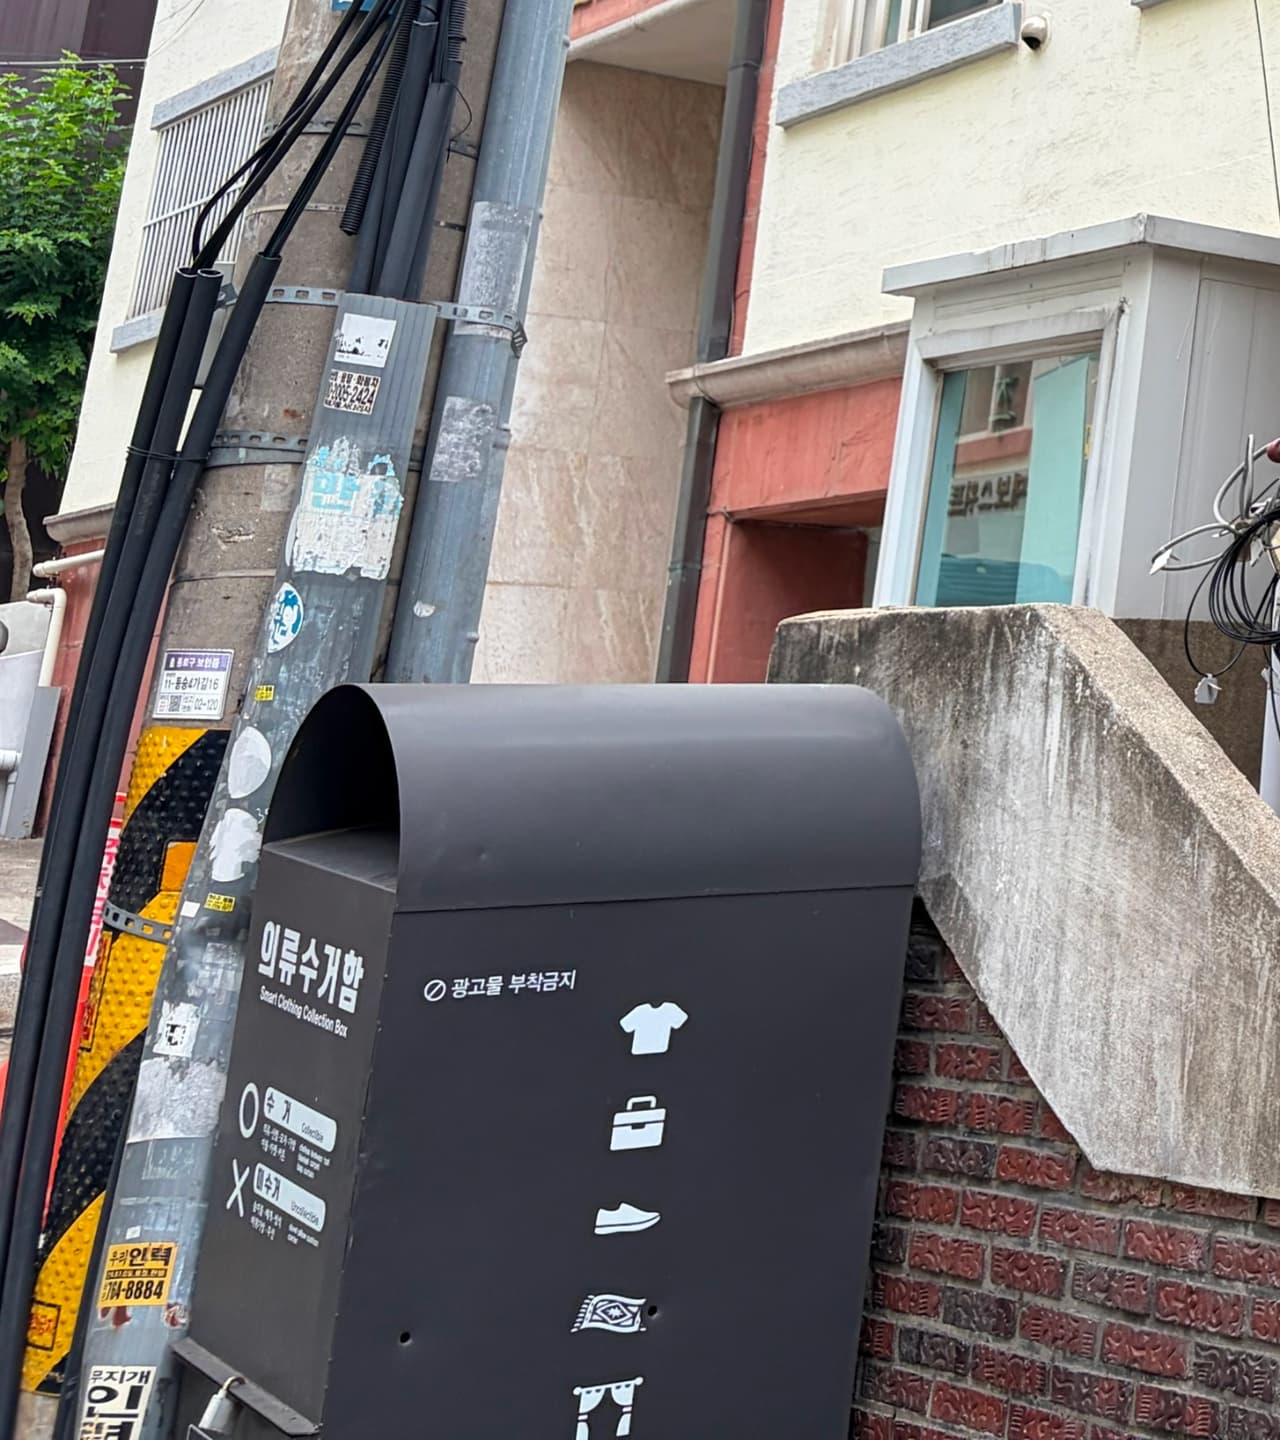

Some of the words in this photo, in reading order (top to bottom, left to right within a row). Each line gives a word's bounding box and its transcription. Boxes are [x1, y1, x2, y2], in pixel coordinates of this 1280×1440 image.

[258, 920, 364, 1014] 의류수거함
[451, 976, 503, 999] 광고물
[508, 969, 577, 994] 부착금지
[260, 985, 278, 1006] Smart
[277, 993, 302, 1020] Clothing
[303, 1004, 334, 1032] Collection
[333, 1018, 348, 1038] Box
[91, 1370, 152, 1385] 무지개
